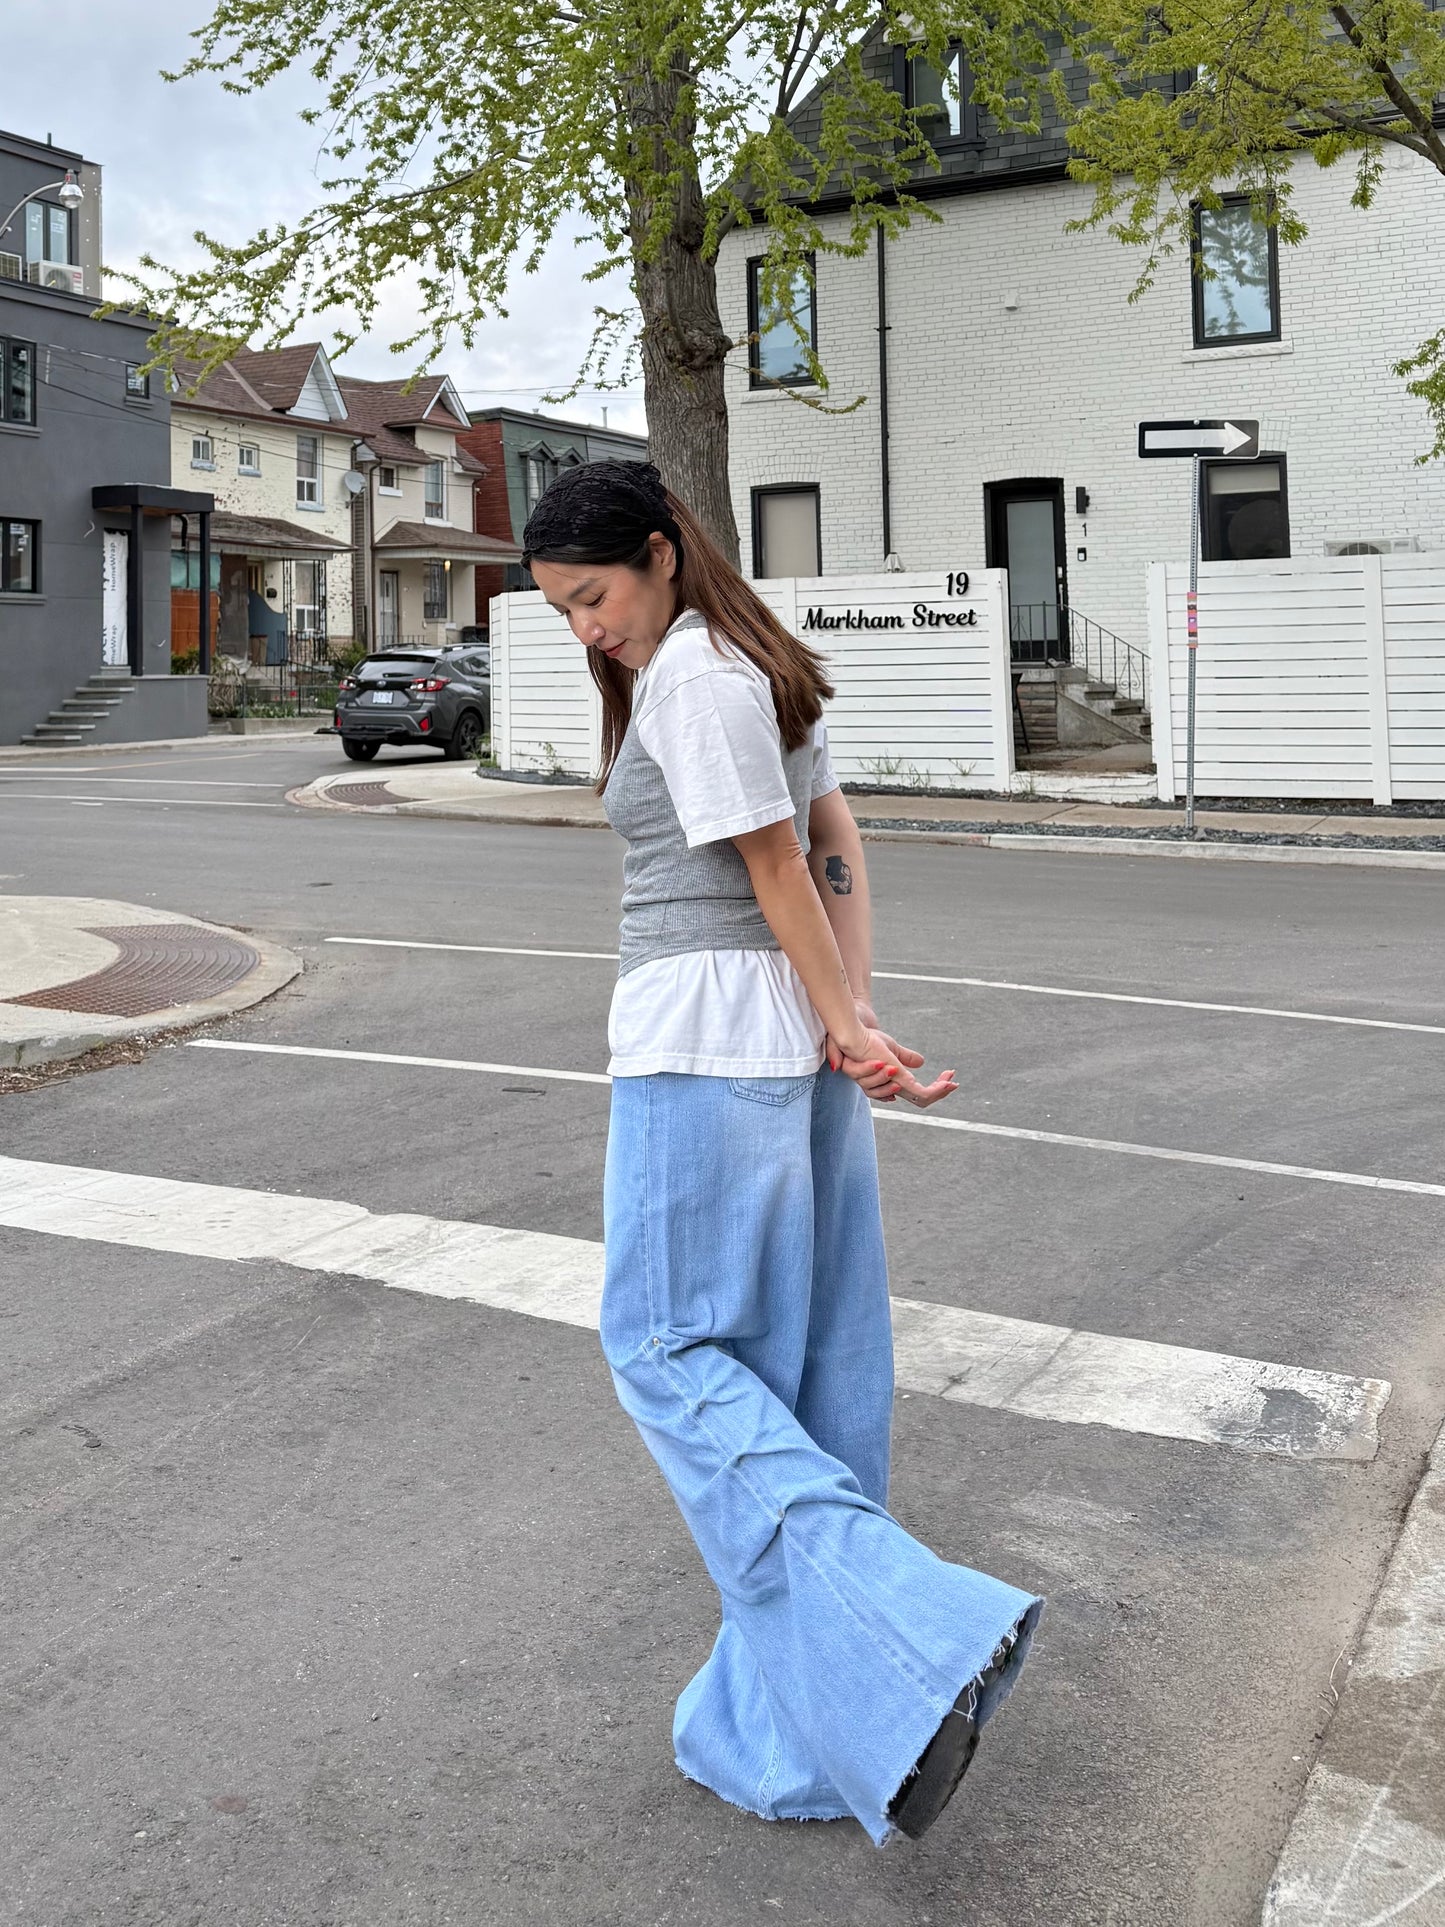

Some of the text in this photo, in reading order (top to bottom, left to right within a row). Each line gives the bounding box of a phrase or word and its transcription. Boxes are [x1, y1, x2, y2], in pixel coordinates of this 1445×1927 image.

[1081, 522, 1087, 537] 1
[946, 572, 969, 596] 19
[802, 604, 977, 630] Markham Street
